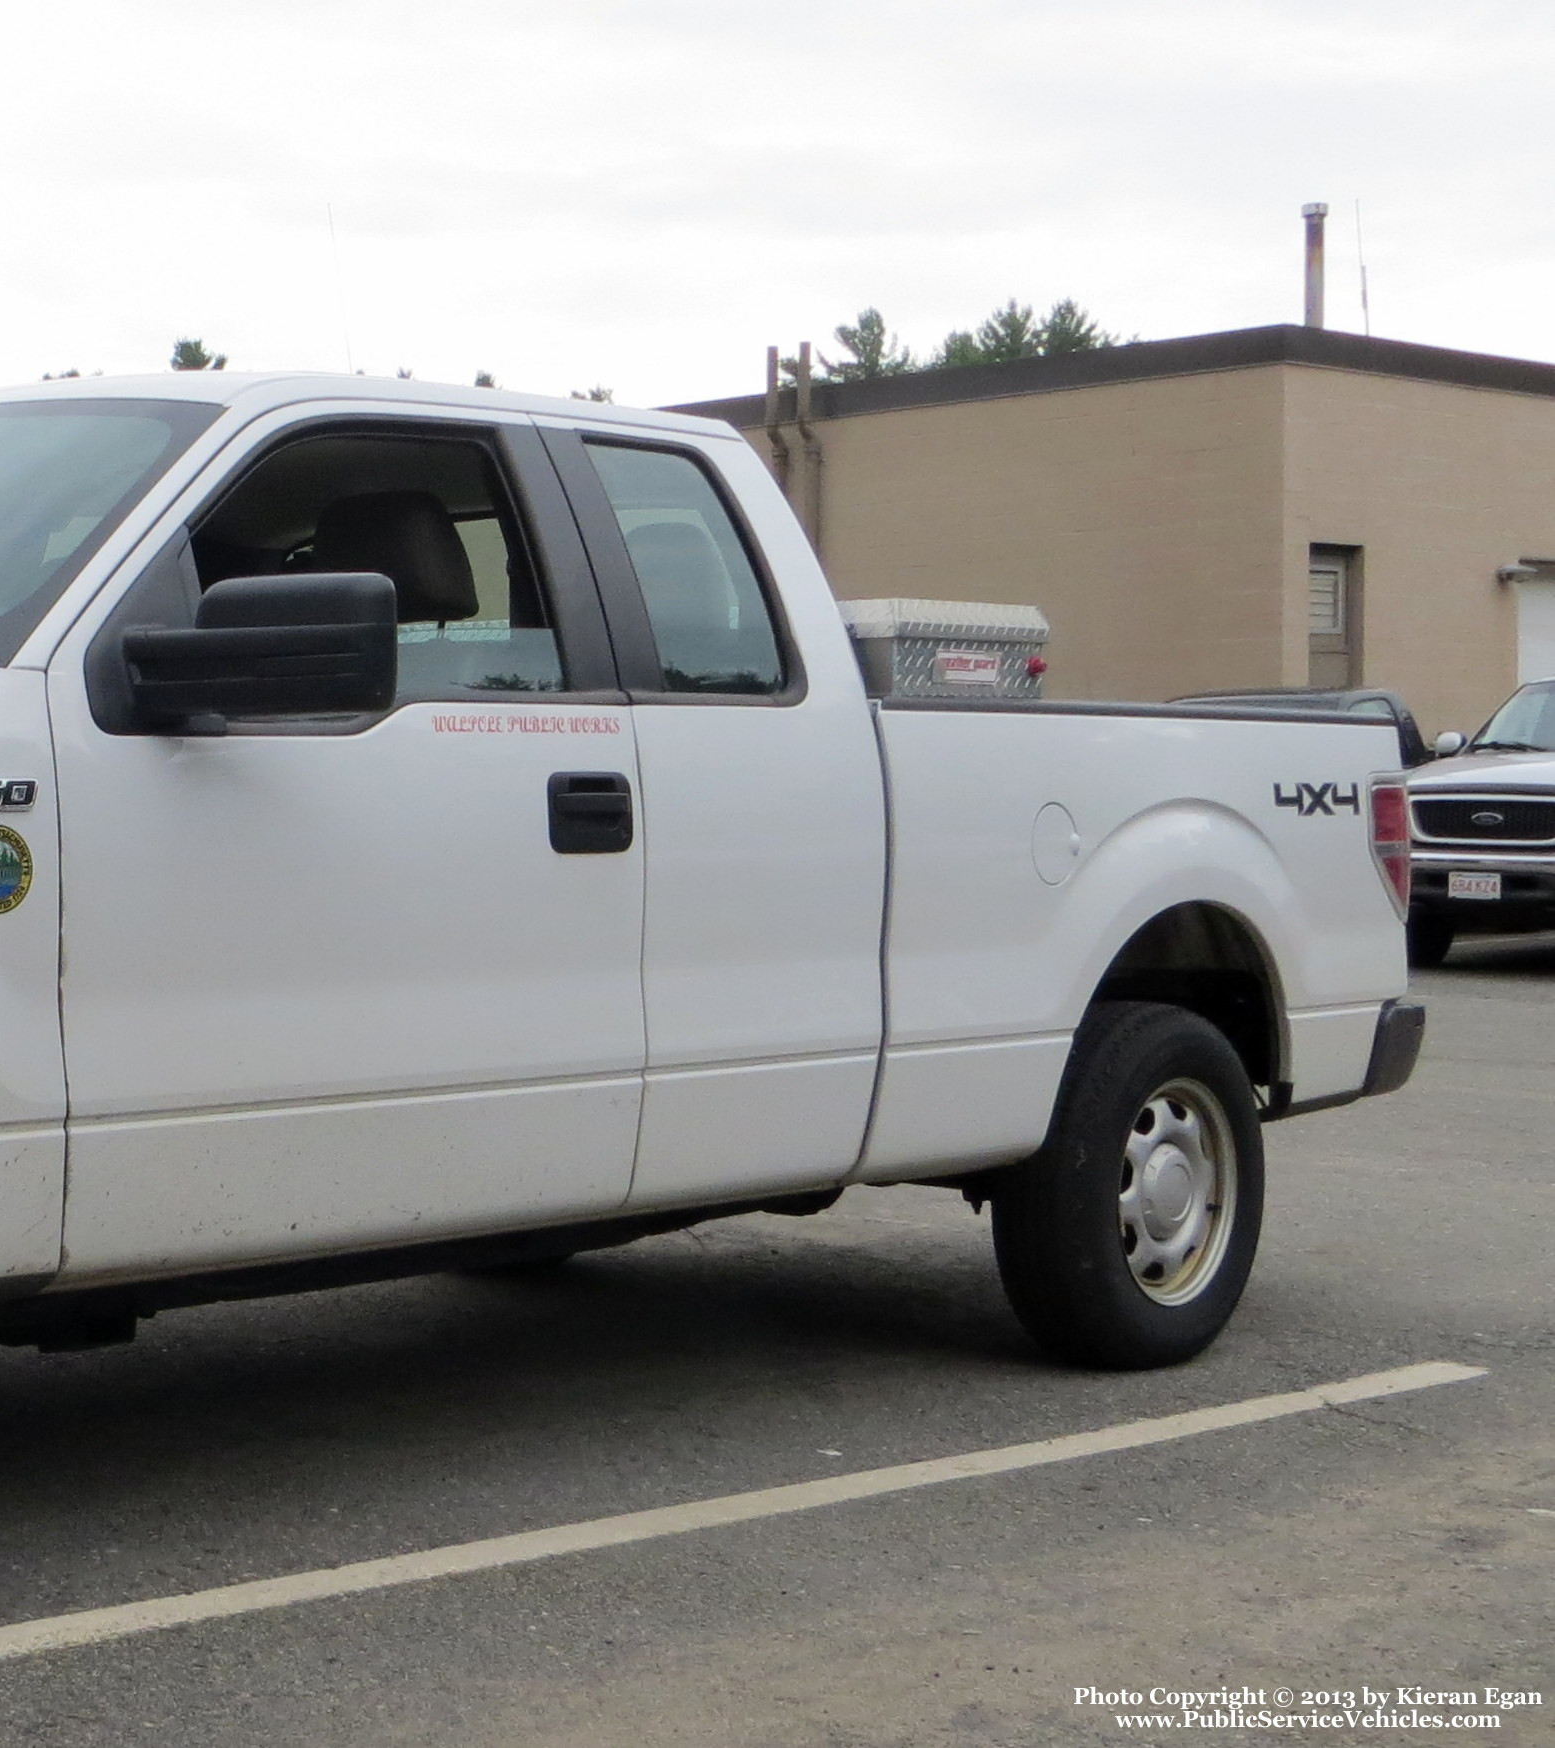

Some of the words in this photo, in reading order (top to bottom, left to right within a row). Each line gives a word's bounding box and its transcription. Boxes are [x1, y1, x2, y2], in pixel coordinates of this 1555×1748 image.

[432, 715, 503, 734] WALPOLE
[506, 716, 566, 735] PUBLIC
[567, 717, 622, 736] WORKS
